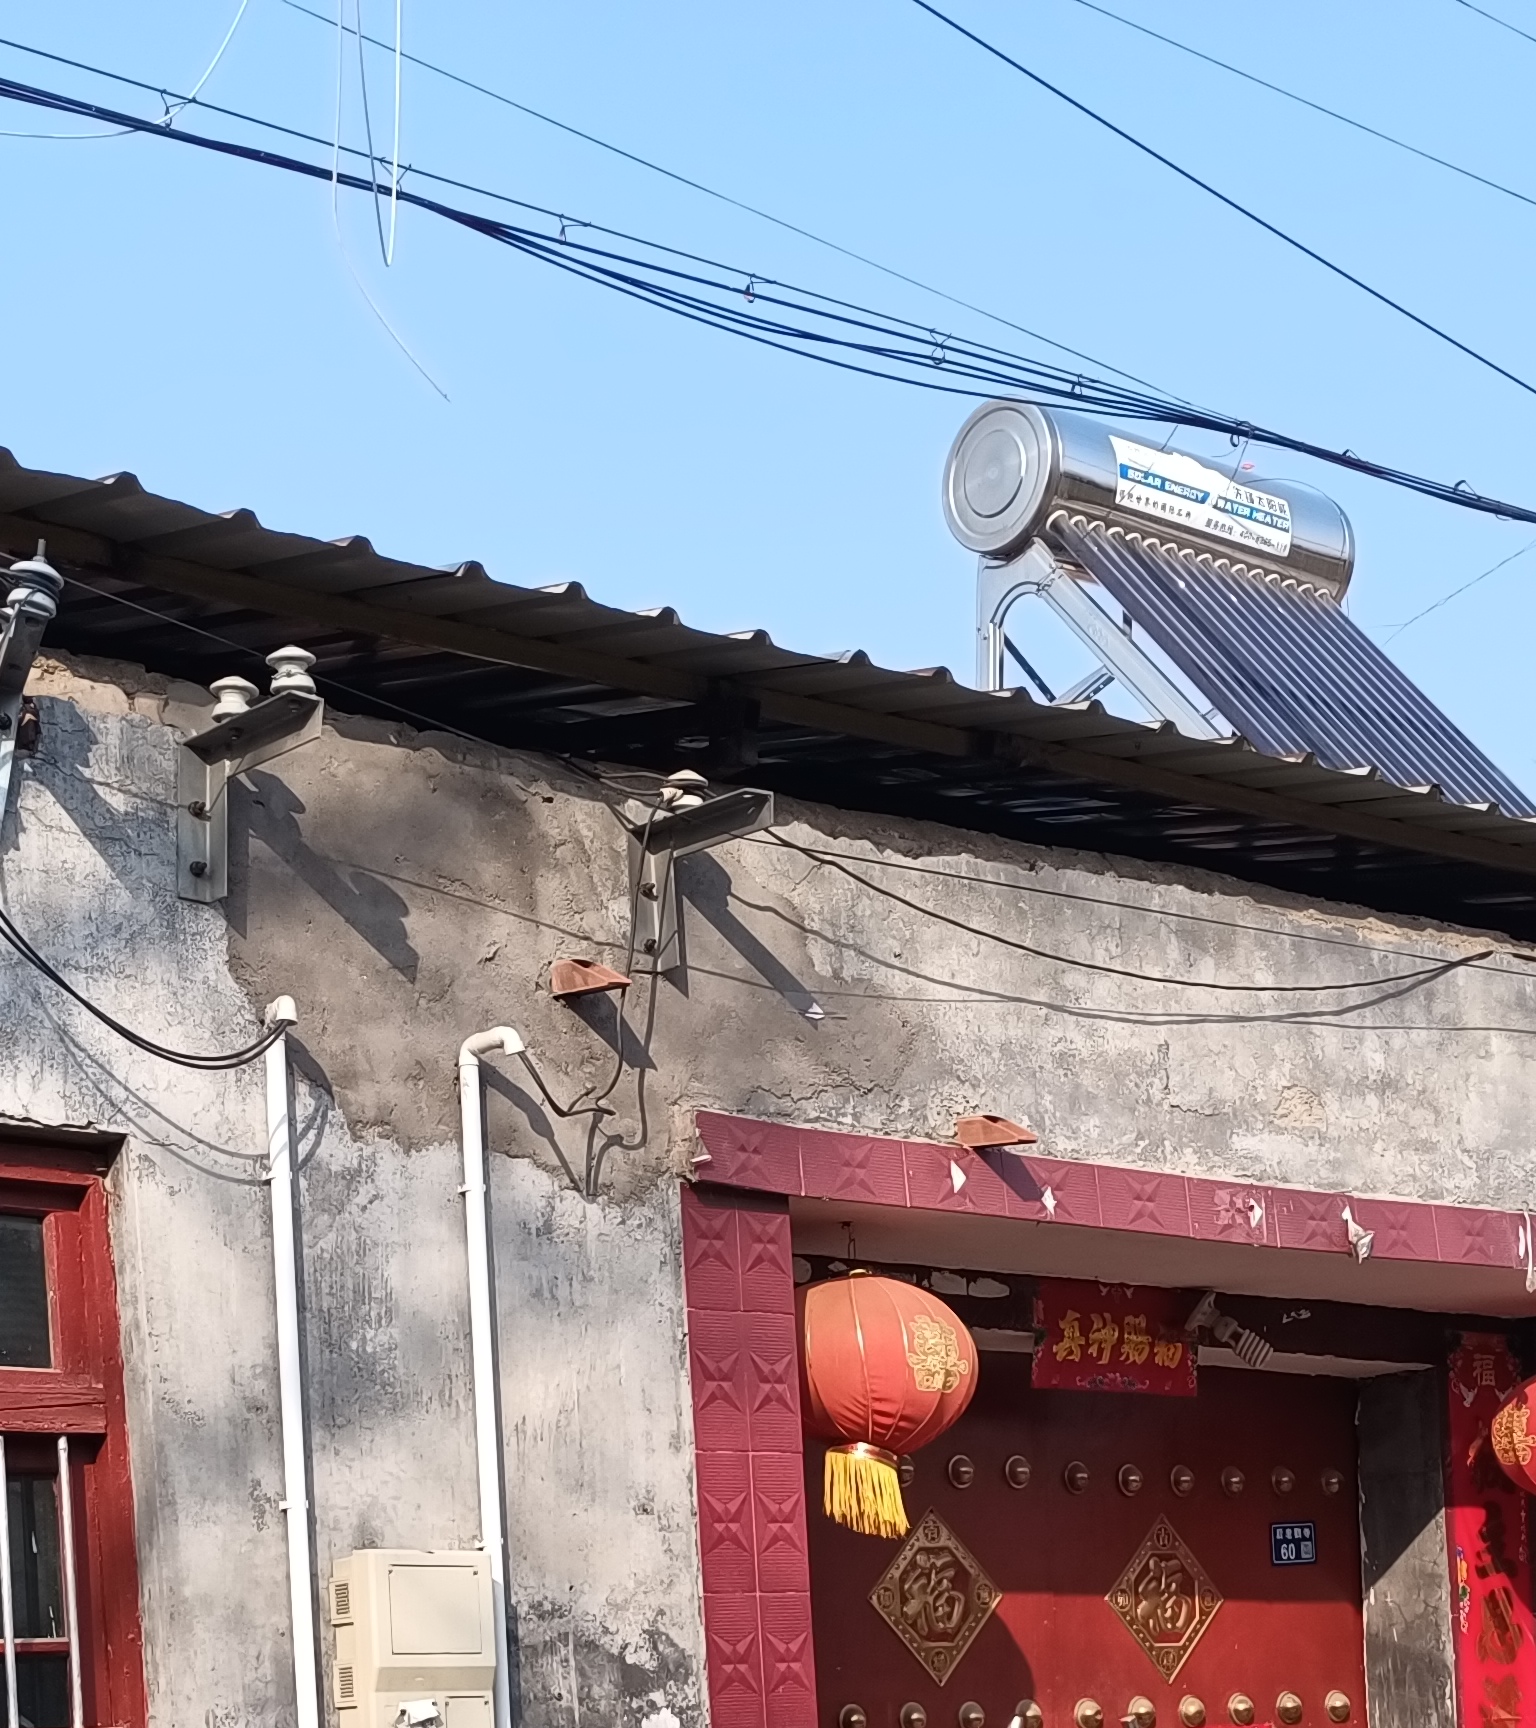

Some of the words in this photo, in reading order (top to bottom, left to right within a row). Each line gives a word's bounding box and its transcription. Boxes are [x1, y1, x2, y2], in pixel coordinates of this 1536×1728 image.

[1128, 468, 1162, 489] SOLAR
[1164, 479, 1205, 504] ENERGY
[1217, 498, 1251, 518] WATER
[1251, 509, 1291, 531] HEATER
[1472, 1353, 1496, 1387] 福
[1280, 1543, 1296, 1560] 60
[902, 1550, 966, 1637] 福
[1136, 1555, 1192, 1636] 福
